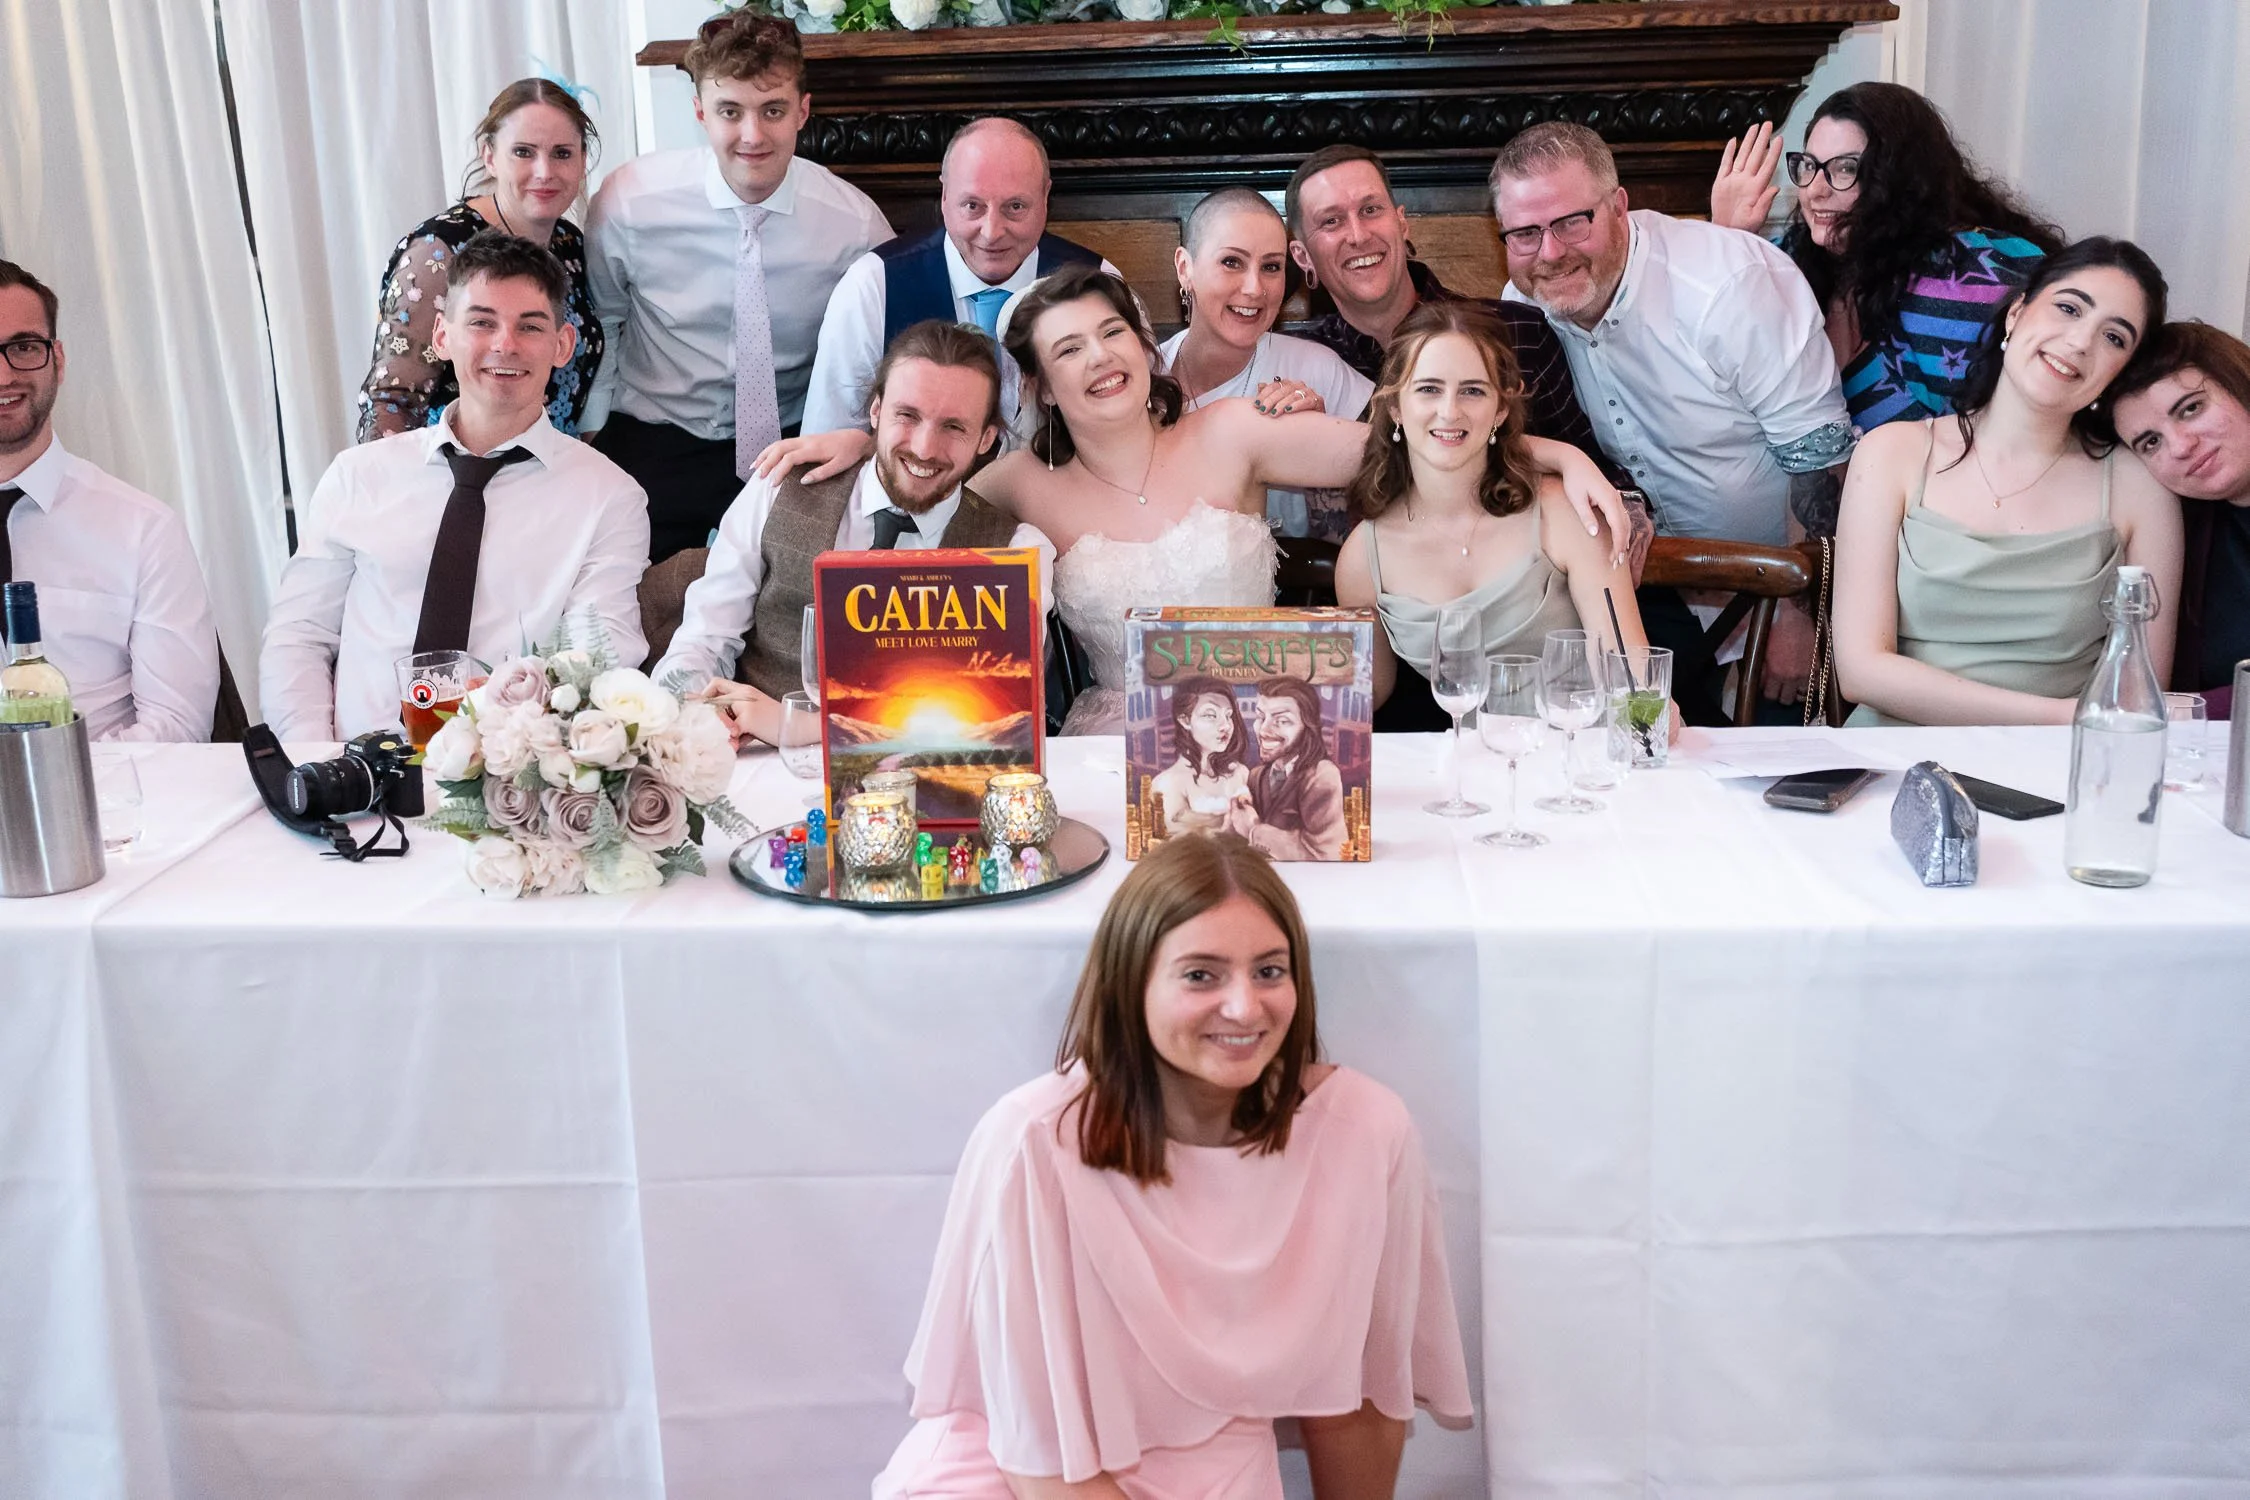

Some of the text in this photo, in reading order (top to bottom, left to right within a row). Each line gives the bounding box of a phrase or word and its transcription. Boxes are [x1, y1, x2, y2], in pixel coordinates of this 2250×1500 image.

[844, 584, 1009, 632] CATAN
[875, 636, 980, 648] MEET LOVE MARRY
[1149, 634, 1353, 683] SHERIFFS
[1211, 667, 1258, 678] PUTNEY
